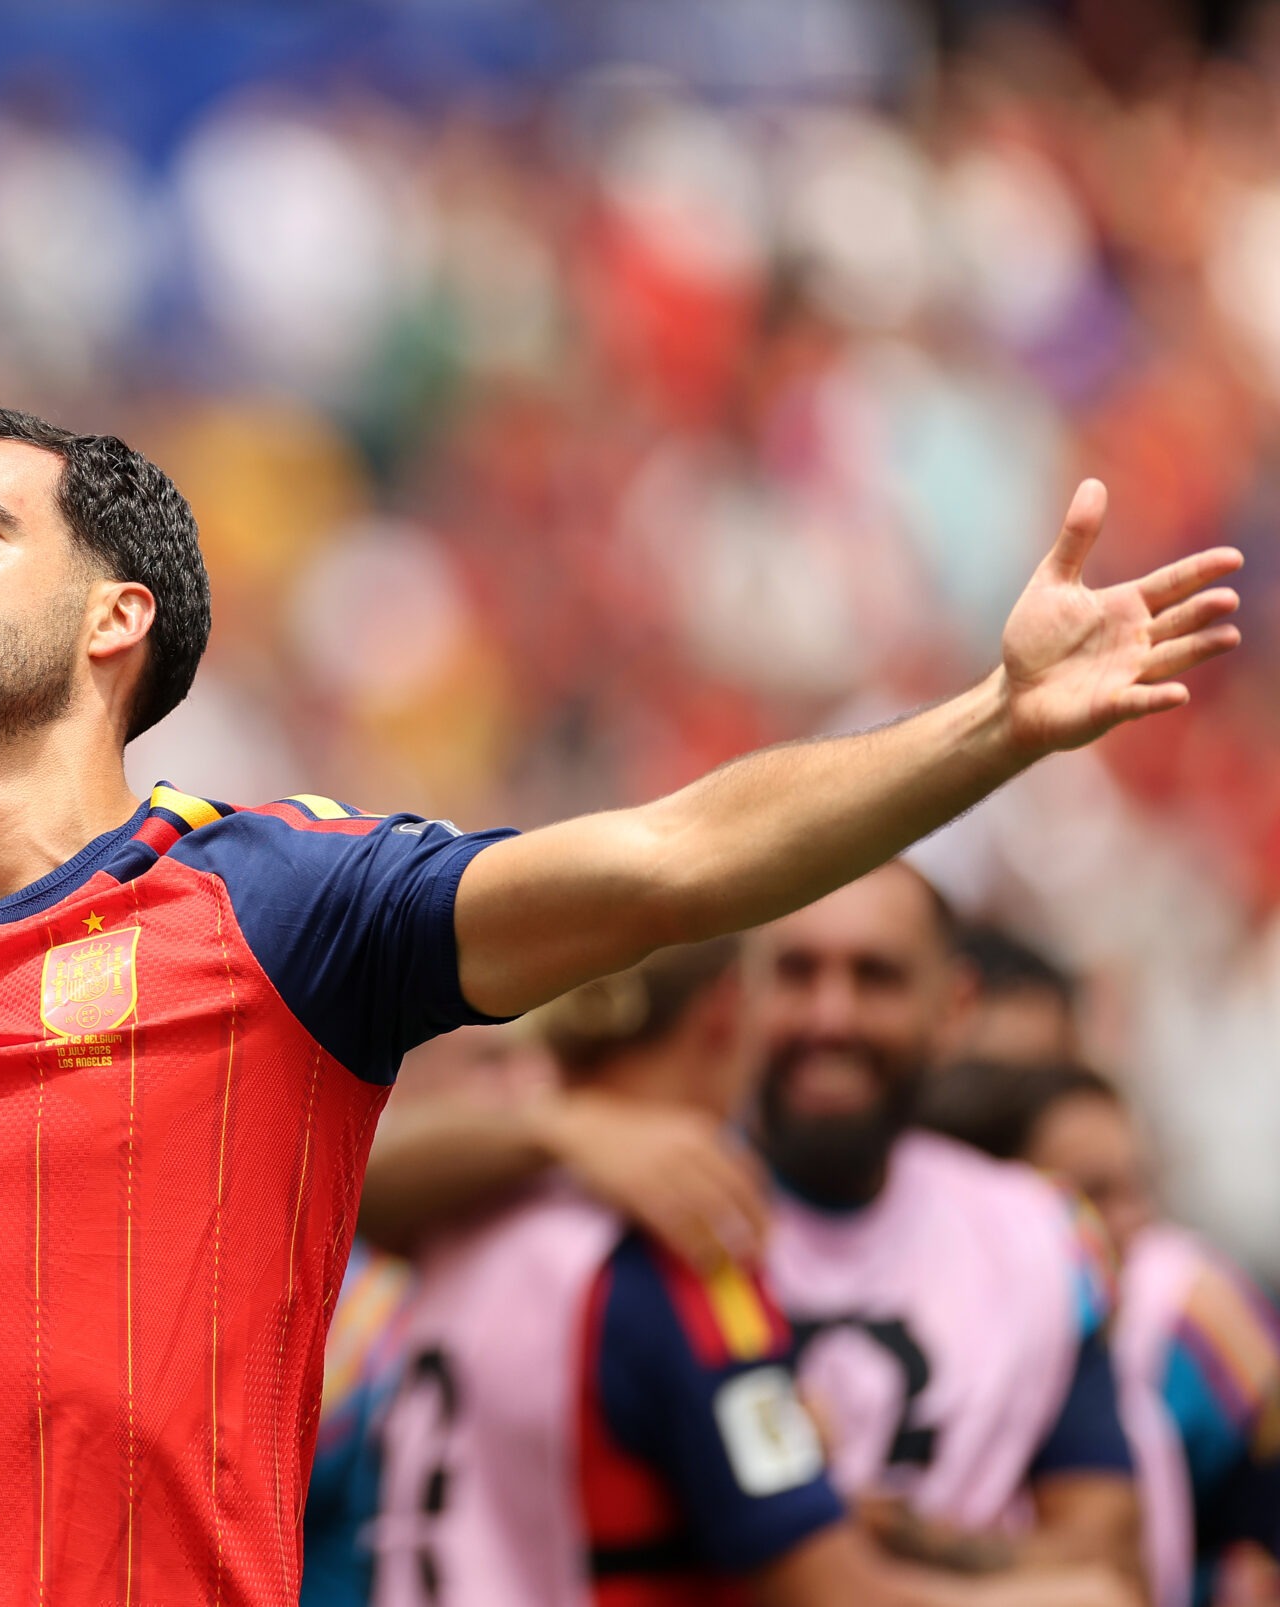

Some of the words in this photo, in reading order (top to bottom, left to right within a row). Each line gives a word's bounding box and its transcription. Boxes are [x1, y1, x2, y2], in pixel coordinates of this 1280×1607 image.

[84, 1034, 122, 1044] BELGIUM
[69, 1046, 86, 1056] JULY
[88, 1045, 111, 1055] 2026
[58, 1058, 74, 1069] LOS
[76, 1056, 113, 1067] ANGELES
